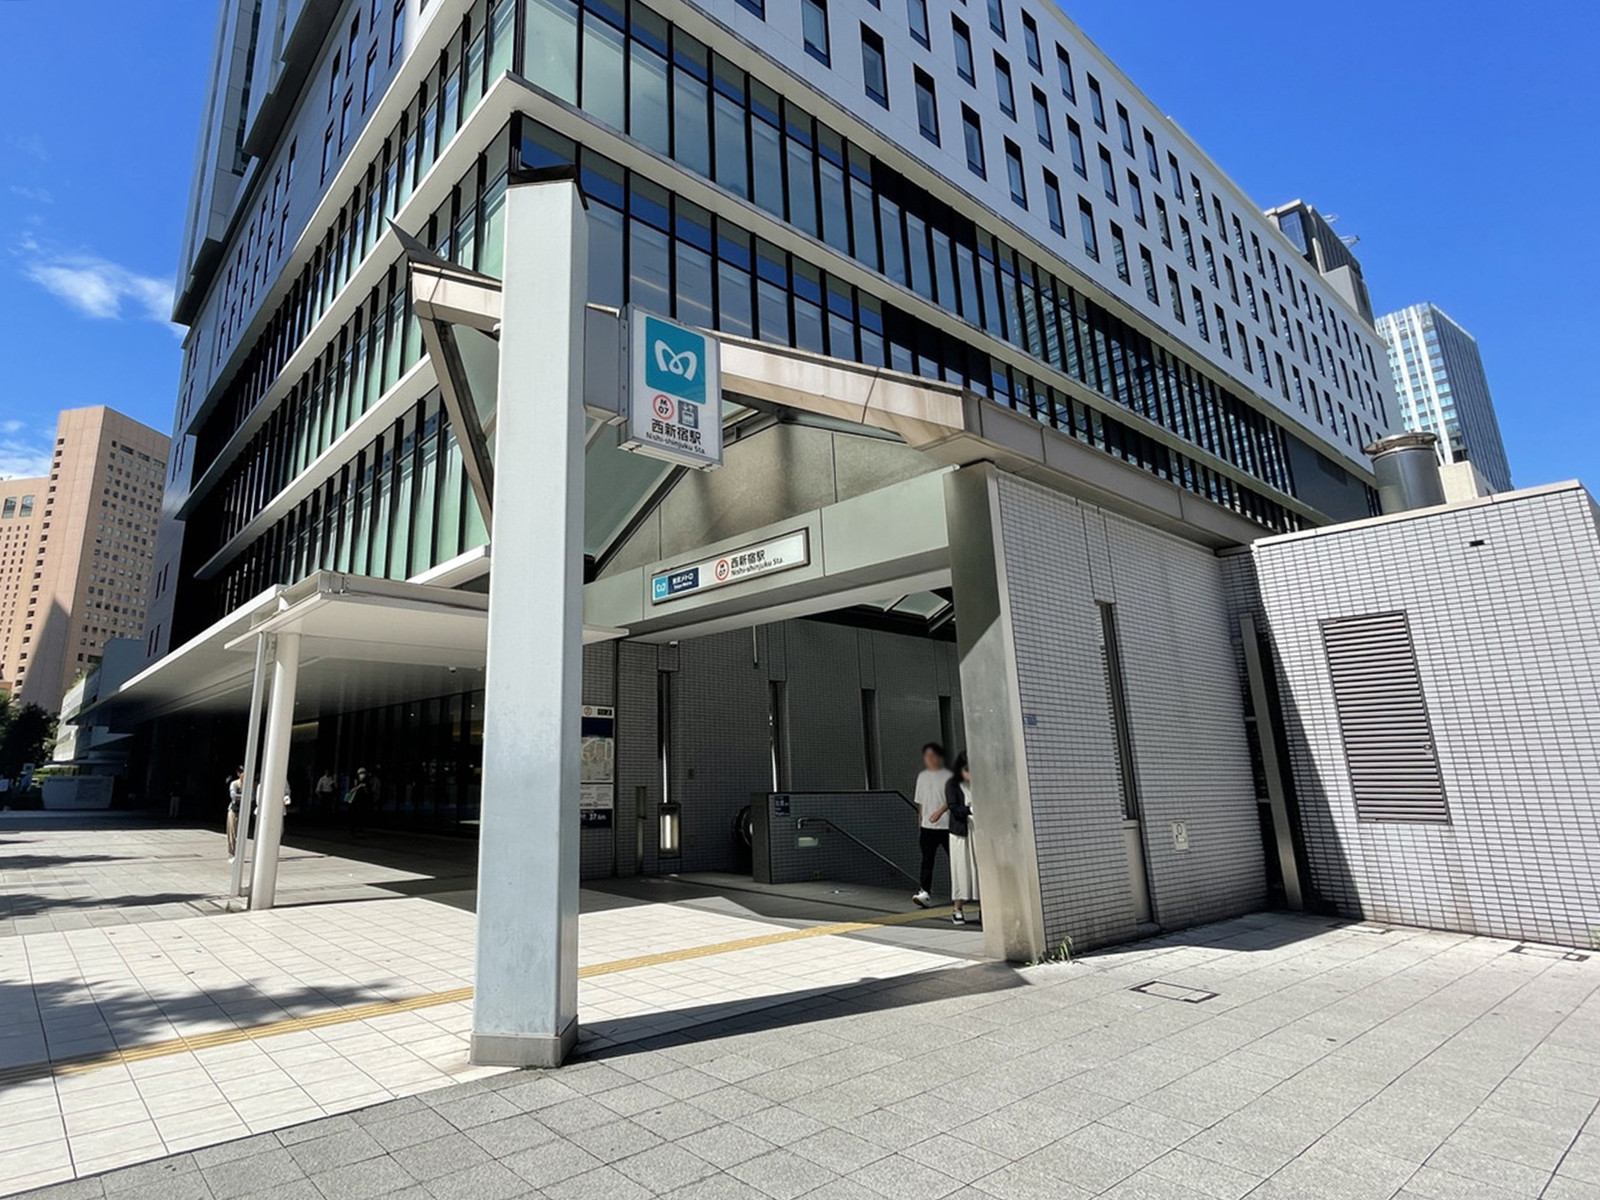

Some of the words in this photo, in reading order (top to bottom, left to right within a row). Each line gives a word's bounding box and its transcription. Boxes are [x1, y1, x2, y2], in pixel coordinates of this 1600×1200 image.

[658, 406, 669, 414] 07
[651, 418, 701, 445] 西新宿駅
[731, 550, 765, 568] 西新宿駅
